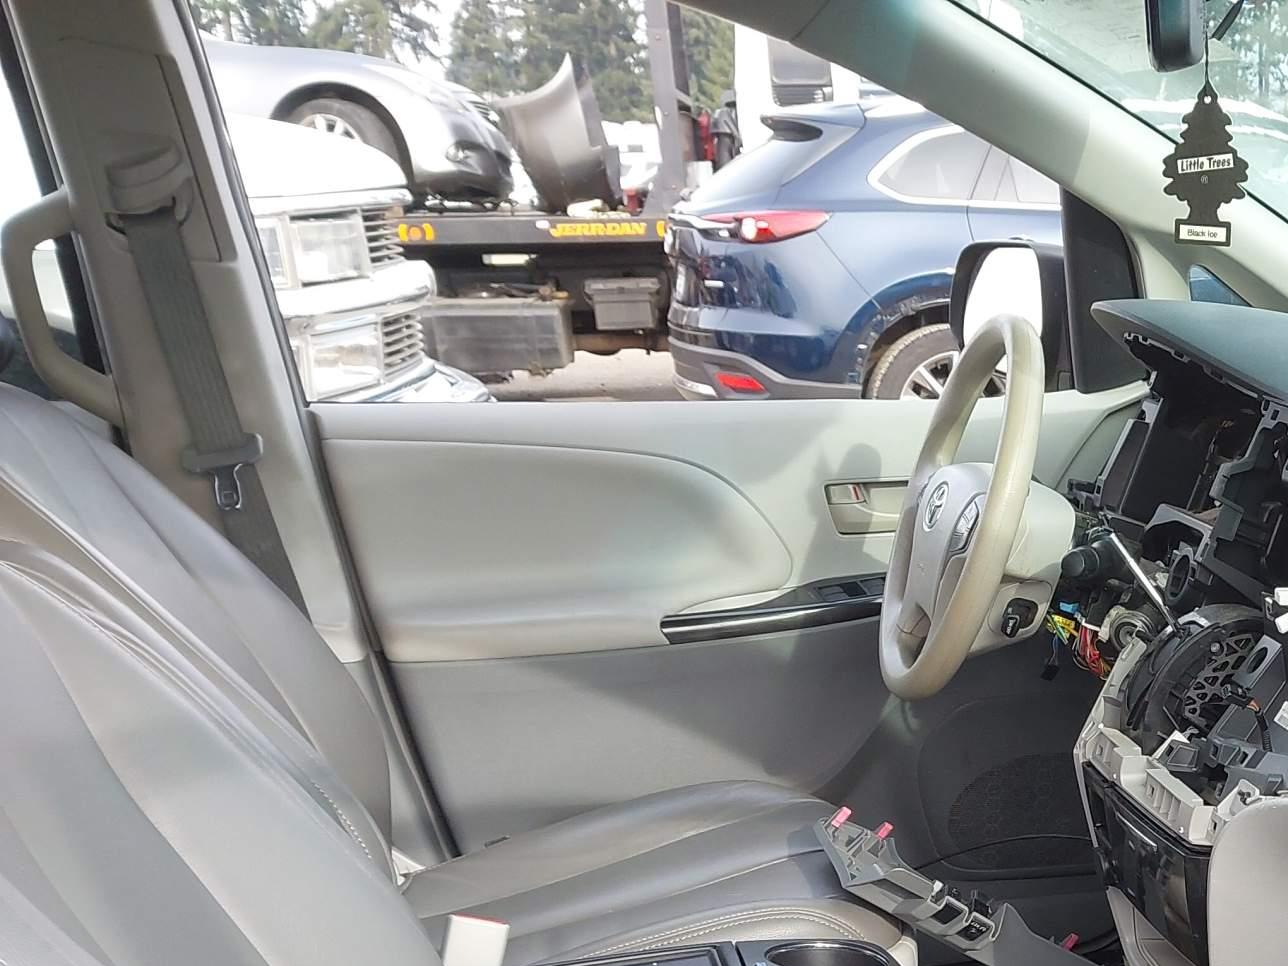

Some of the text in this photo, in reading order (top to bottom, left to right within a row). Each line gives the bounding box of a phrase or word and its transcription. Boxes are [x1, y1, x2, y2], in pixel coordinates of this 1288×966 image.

[1181, 157, 1231, 172] Little Trees
[1187, 228, 1218, 238] Black Ice
